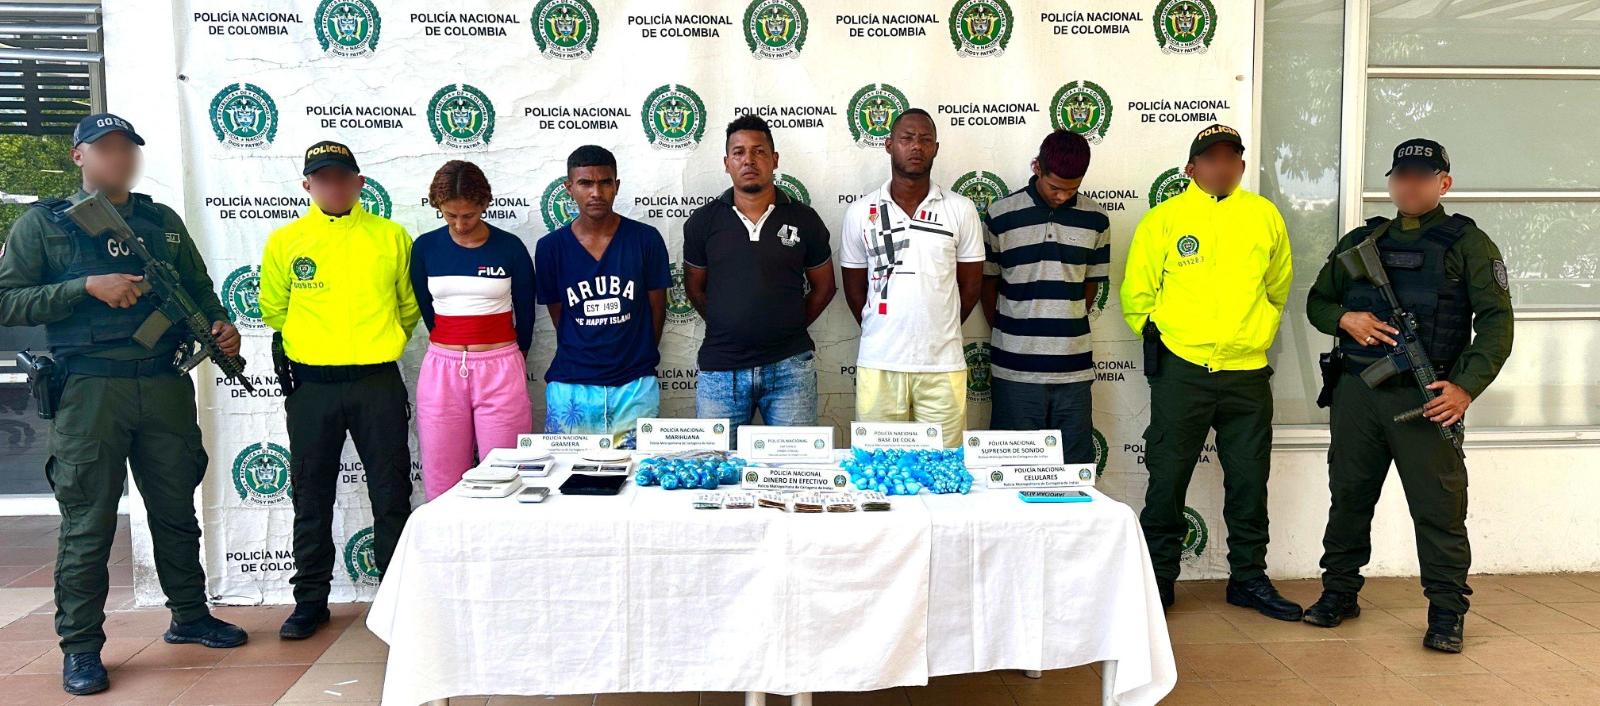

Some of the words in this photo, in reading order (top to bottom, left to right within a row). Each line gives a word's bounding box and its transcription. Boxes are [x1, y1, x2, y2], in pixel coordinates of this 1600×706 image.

[195, 11, 239, 22] POLICÍA
[242, 13, 303, 23] NACIONAL
[411, 12, 456, 22] POLICÍA
[460, 14, 520, 23] NACIONAL
[628, 14, 672, 25] POLICÍA
[675, 15, 732, 24] NACIONAL
[837, 14, 879, 24] POLICÍA
[883, 14, 939, 24] NACIONAL
[1041, 11, 1084, 22] POLICÍA
[1087, 12, 1143, 21] NACIONAL
[209, 26, 224, 34] DE
[228, 26, 288, 35] COLOMBIA
[426, 27, 441, 35] DE
[445, 27, 506, 36] COLOMBIA
[642, 29, 656, 37] DE
[660, 28, 719, 37] COLOMBIA
[850, 28, 864, 37] DE
[868, 27, 926, 37] COLOMBIA
[1054, 26, 1068, 34] DE
[1072, 25, 1129, 34] COLOMBIA
[939, 103, 980, 113] POLICÍA
[983, 103, 1039, 113] NACIONAL
[1129, 100, 1171, 110] POLICÍA
[1174, 101, 1230, 109] NACIONAL
[307, 105, 352, 115] POLICÍA
[356, 107, 416, 116] NACIONAL
[525, 106, 570, 116] POLICÍA
[574, 108, 631, 116] NACIONAL
[734, 105, 778, 116] POLICÍA
[781, 107, 837, 116] NACIONAL
[951, 117, 964, 126] DE
[969, 116, 1025, 125] COLOMBIA
[1142, 114, 1155, 122] DE
[1159, 113, 1217, 122] COLOMBIA
[97, 118, 128, 129] GOES
[321, 119, 336, 128] DE
[340, 119, 403, 128] COLOMBIA
[540, 121, 554, 129] DE
[558, 121, 617, 129] COLOMBIA
[767, 119, 824, 128] COLOMBIA
[1398, 146, 1433, 158] GOES
[1084, 190, 1138, 199] NACIONAL
[206, 196, 251, 206] POLICÍA
[635, 195, 678, 206] POLICÍA
[221, 210, 236, 218] DE
[240, 210, 299, 218] COLOMBIA
[649, 210, 663, 218] DE
[478, 267, 505, 276] FILA
[566, 276, 634, 307] ARUBA
[587, 304, 599, 312] EST
[604, 302, 618, 311] 1499
[1092, 361, 1136, 370] ACIONAL
[231, 389, 246, 398] DE
[343, 474, 358, 483] DE
[226, 550, 272, 561] POLICÍA
[242, 563, 257, 572] DE
